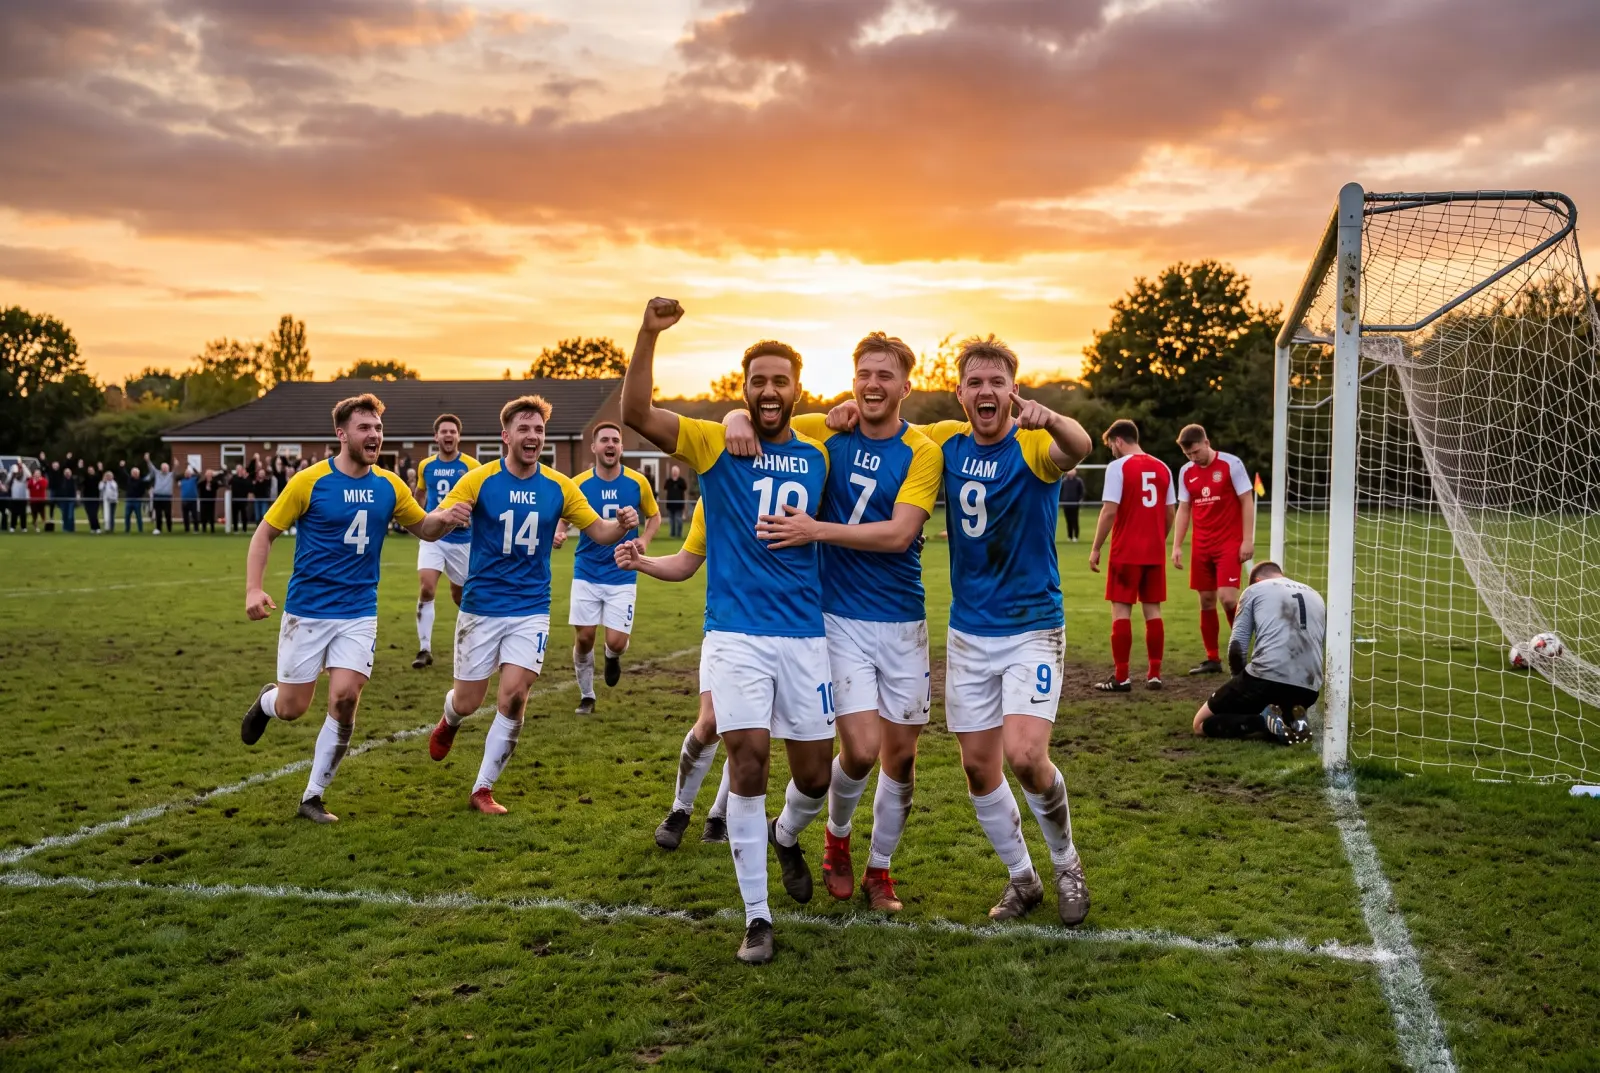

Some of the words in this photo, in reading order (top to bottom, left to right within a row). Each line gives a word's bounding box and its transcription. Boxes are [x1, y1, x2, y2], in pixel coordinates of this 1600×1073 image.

[752, 453, 809, 474] AHMED
[853, 449, 881, 472] LEO
[961, 456, 998, 479] LIAM
[343, 489, 375, 503] MIKE
[509, 490, 537, 505] MKE
[849, 472, 877, 525] 7
[1141, 471, 1158, 508] 5
[752, 476, 809, 539] 10
[959, 480, 988, 538] 9
[343, 509, 370, 555] 4
[499, 509, 540, 556] 14
[627, 604, 633, 621] 5
[1291, 592, 1307, 630] 1
[1035, 663, 1052, 695] 9
